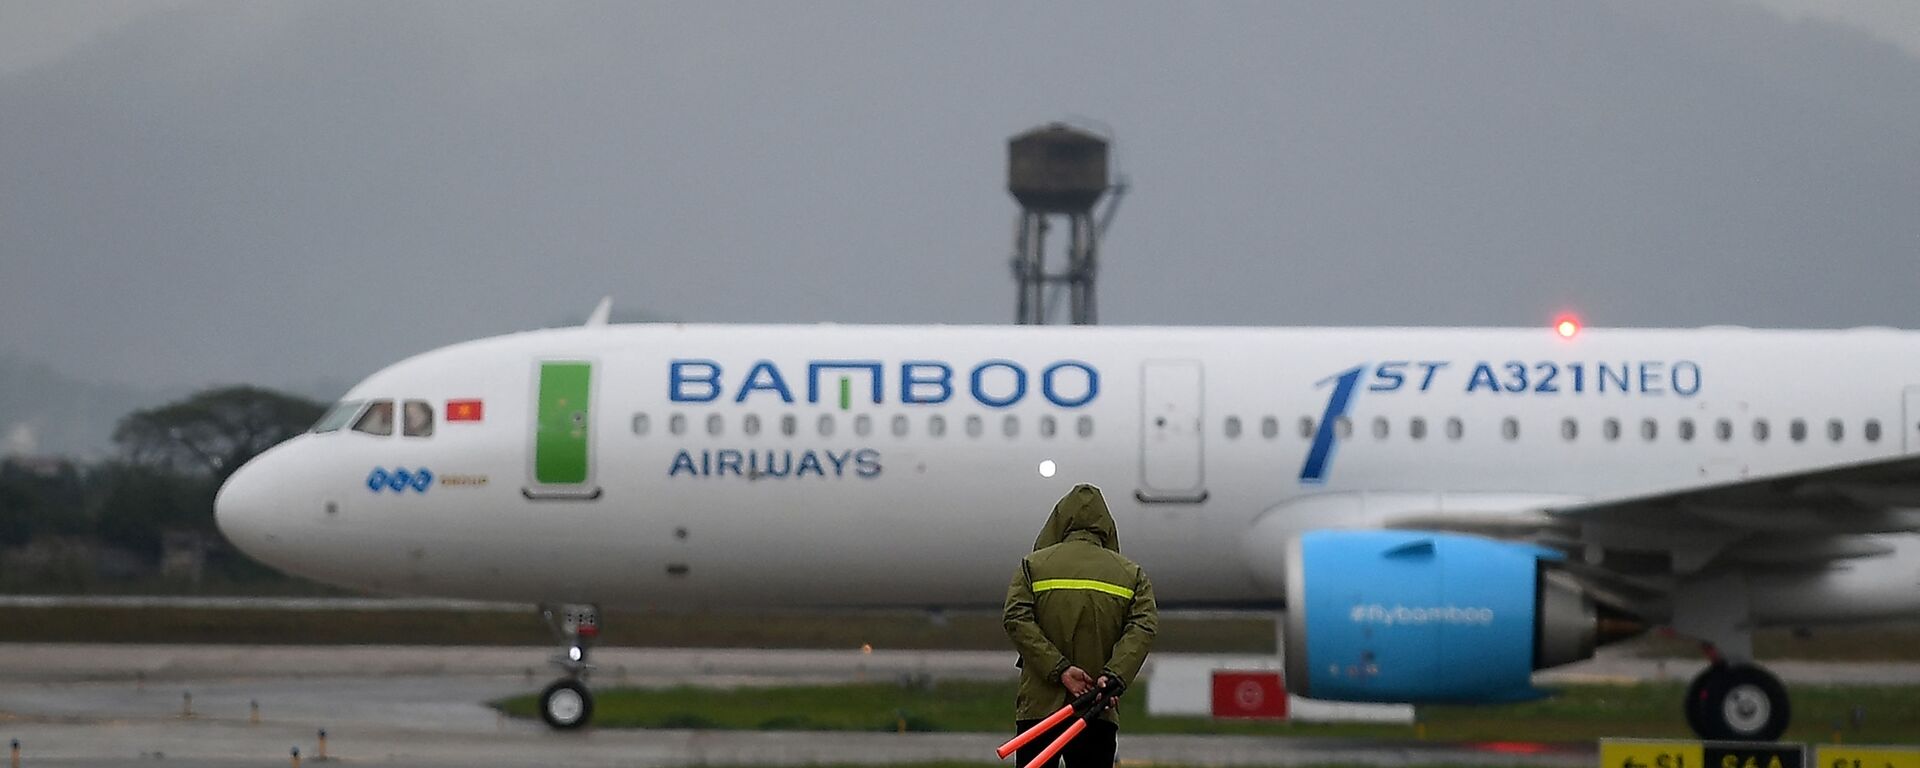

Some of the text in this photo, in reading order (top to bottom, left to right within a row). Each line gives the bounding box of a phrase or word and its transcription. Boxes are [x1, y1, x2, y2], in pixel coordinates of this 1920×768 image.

[668, 358, 1100, 409] BAMBOO
[1299, 360, 1450, 483] 1ST
[668, 448, 882, 477] AIRWAYS
[1351, 604, 1494, 624] #flybamboo
